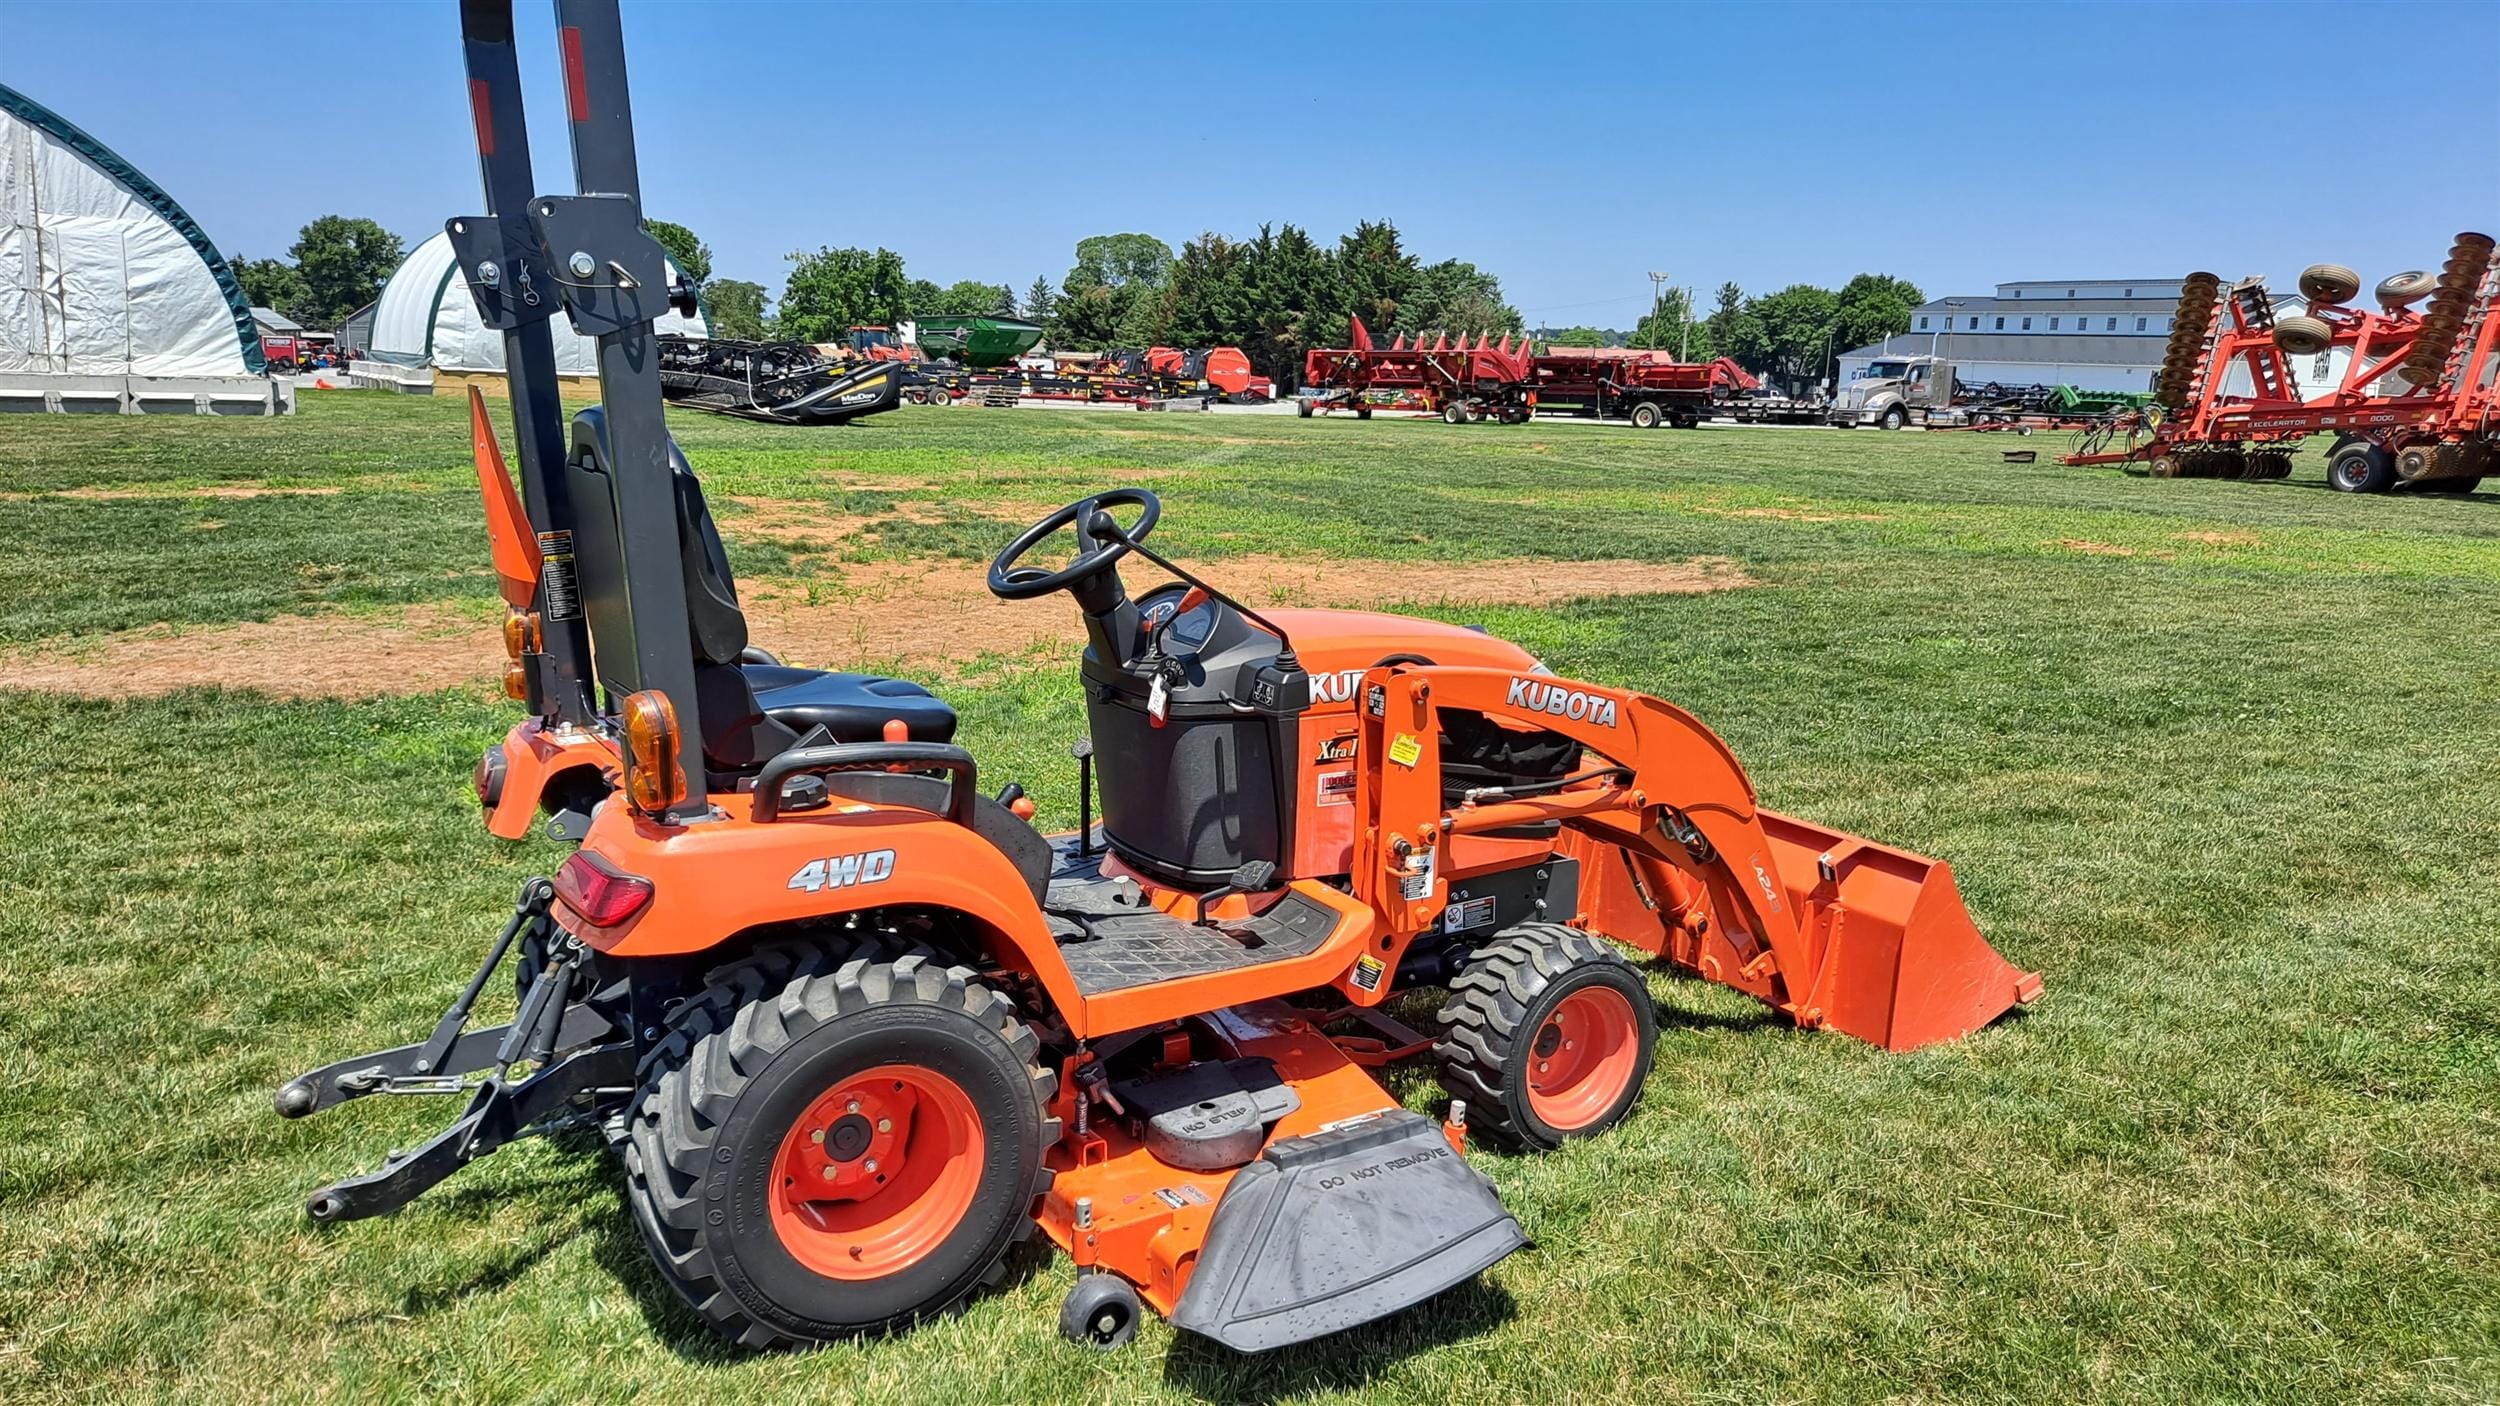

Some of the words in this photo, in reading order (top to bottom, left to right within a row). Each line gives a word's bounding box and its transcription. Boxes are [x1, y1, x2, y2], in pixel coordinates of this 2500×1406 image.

[1505, 676, 1617, 728] KUBOTA
[1316, 740, 1347, 761] Xtra
[786, 848, 897, 893] 4WD
[1182, 1121, 1207, 1134] NO
[1208, 1107, 1247, 1124] STEP
[1319, 1176, 1346, 1190] DO
[1350, 1164, 1383, 1181] NOT
[1384, 1147, 1449, 1171] REMOVE
